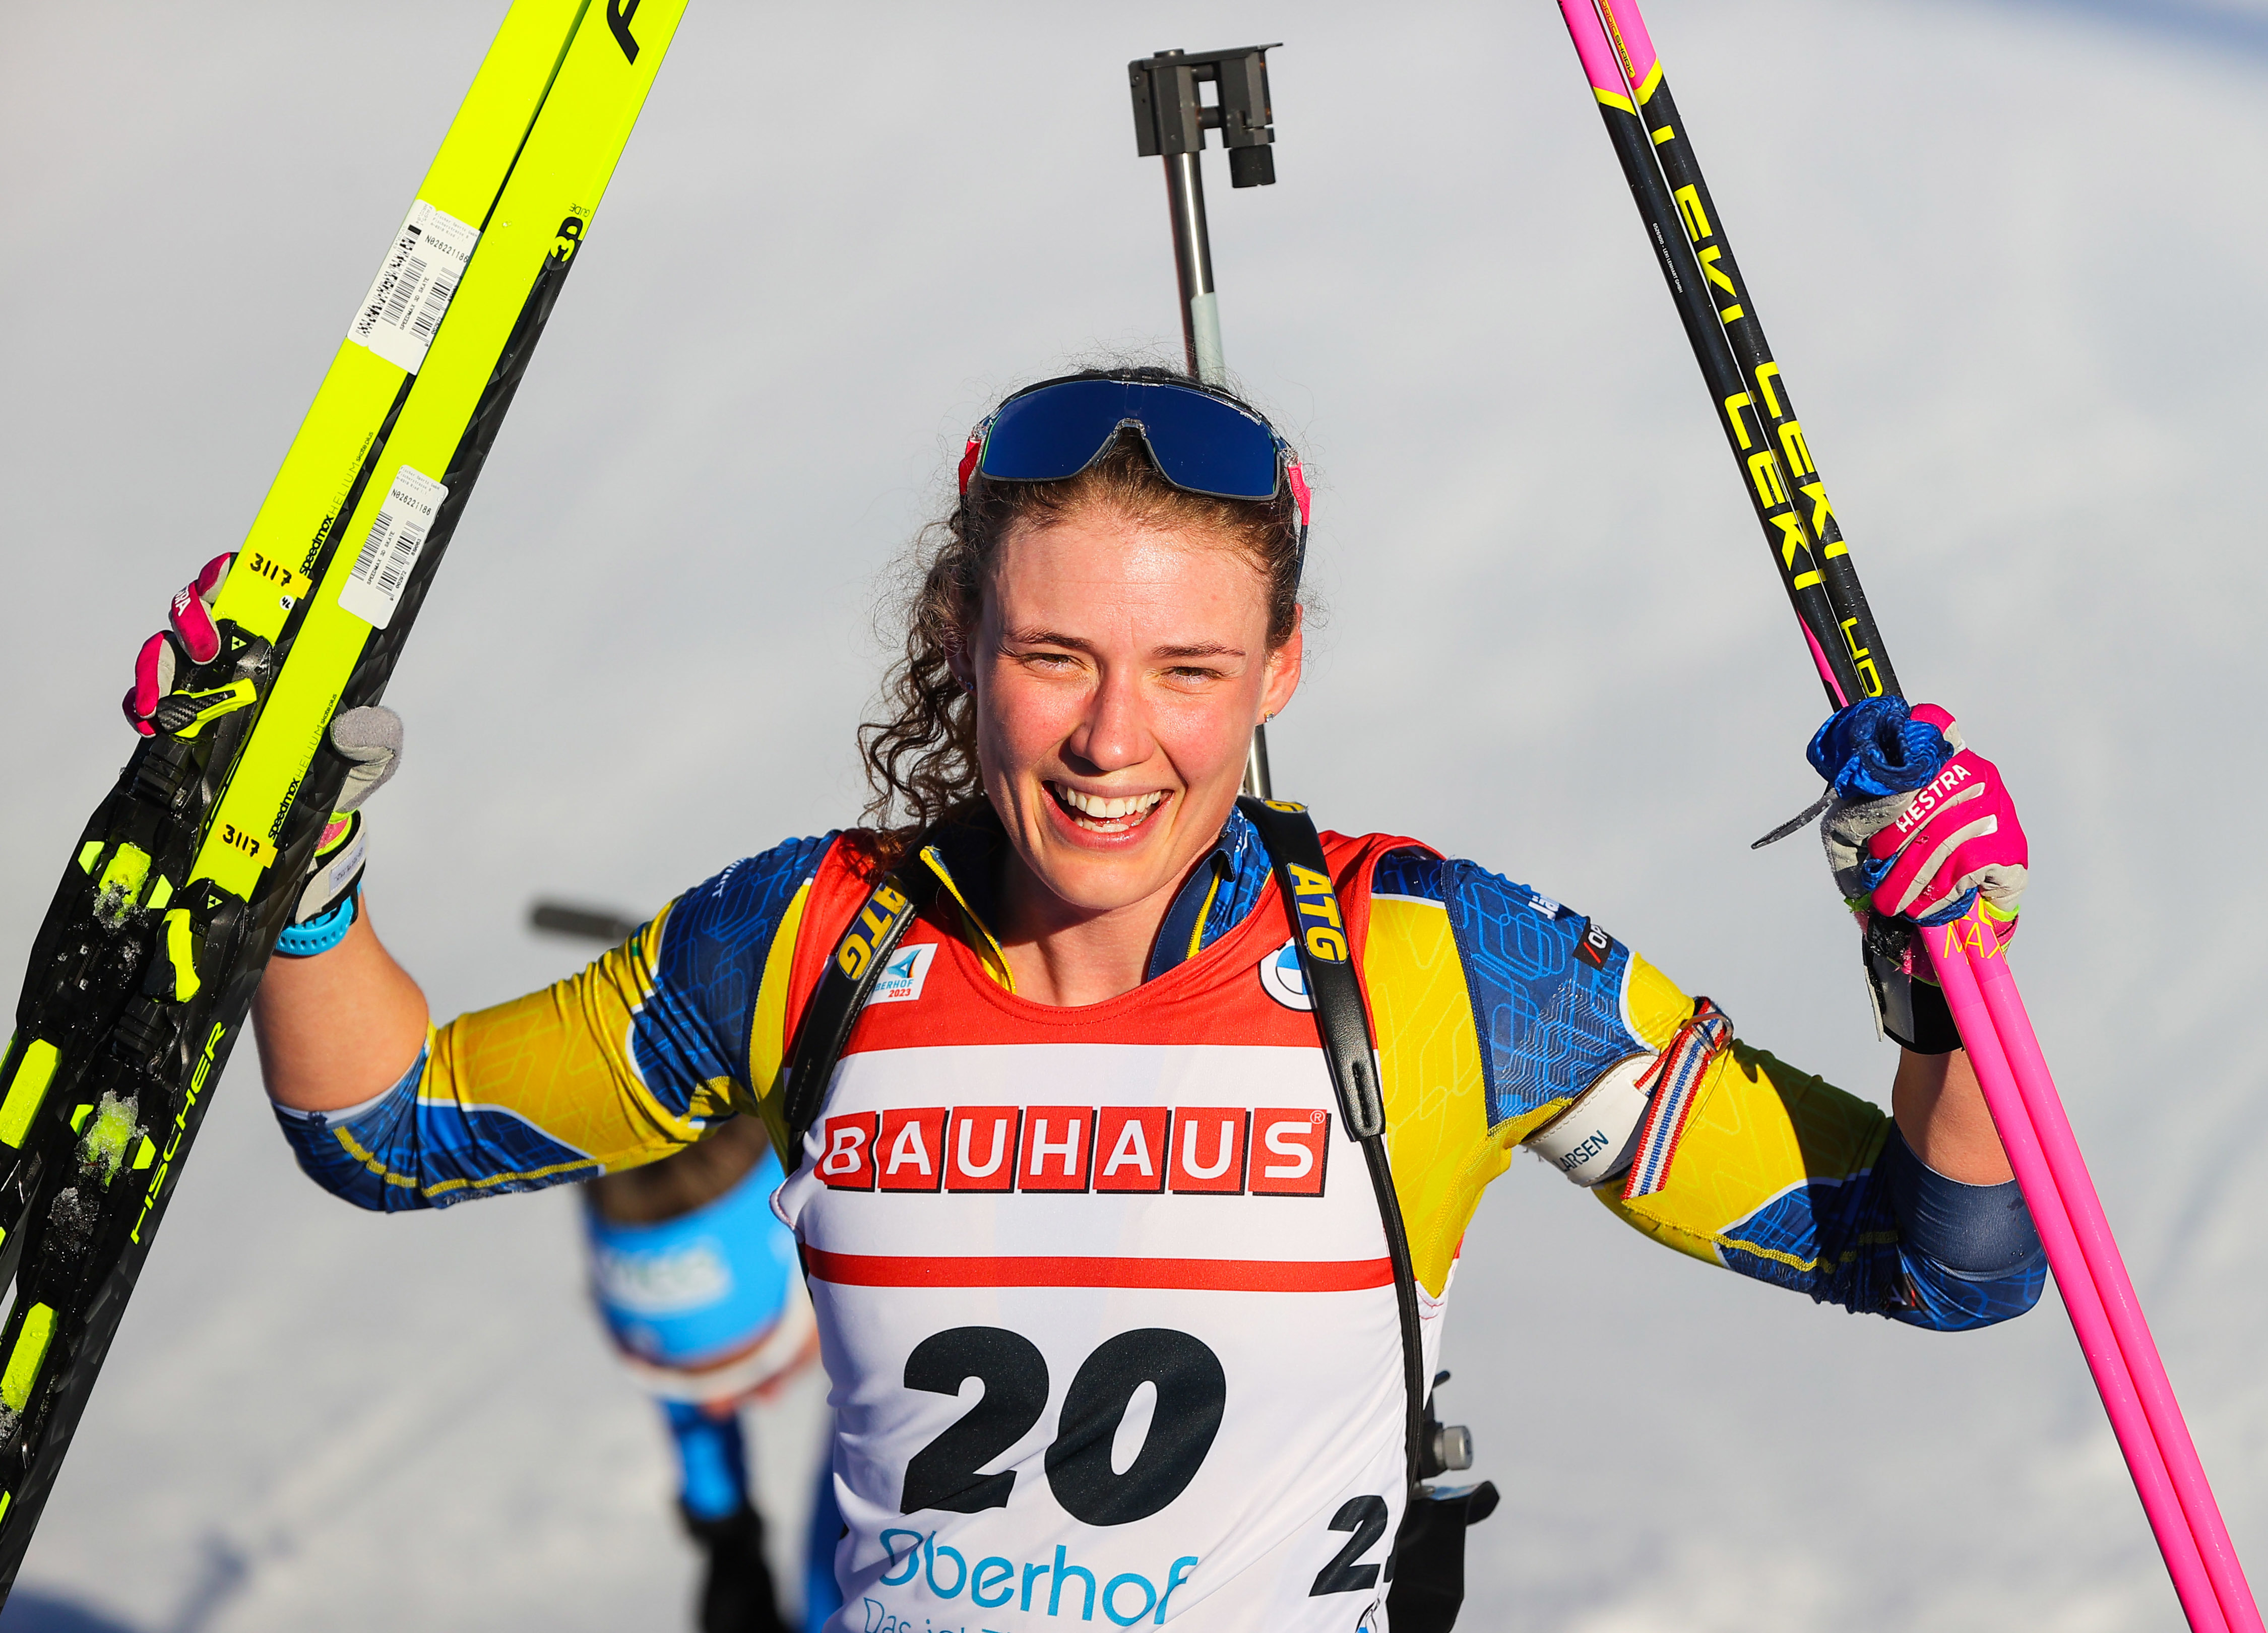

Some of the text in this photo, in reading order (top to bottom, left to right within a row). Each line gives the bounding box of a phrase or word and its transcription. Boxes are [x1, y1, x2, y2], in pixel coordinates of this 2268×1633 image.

[1615, 35, 1633, 75] SHARK
[425, 235, 469, 263] N026221186
[550, 217, 583, 262] 3D
[400, 304, 415, 330] SPEEDMAX
[418, 277, 429, 293] SKATE
[356, 445, 367, 462] skate
[365, 431, 374, 445] plus
[1754, 361, 1848, 559] LEKI
[391, 488, 432, 516] N026221186
[1724, 392, 1822, 590] LEKI
[249, 552, 292, 587] 3117
[367, 559, 382, 585] SPEEDMAX
[385, 530, 395, 547] SKATE
[320, 706, 331, 725] skate
[329, 693, 337, 710] plus
[1895, 764, 1972, 834] HESTRA
[222, 824, 260, 857] 3117
[838, 878, 906, 979] ATG
[1289, 864, 1347, 963] ATG
[874, 979, 914, 991] BERHOF
[888, 988, 911, 997] 2023
[131, 1021, 226, 1245] FISCHER
[822, 1117, 1313, 1180] BAUHAUS
[1552, 1129, 1609, 1172] LARSEN
[901, 1326, 1226, 1526] 20
[1308, 1495, 1396, 1597] 2
[878, 1528, 1199, 1626] Oberhof
